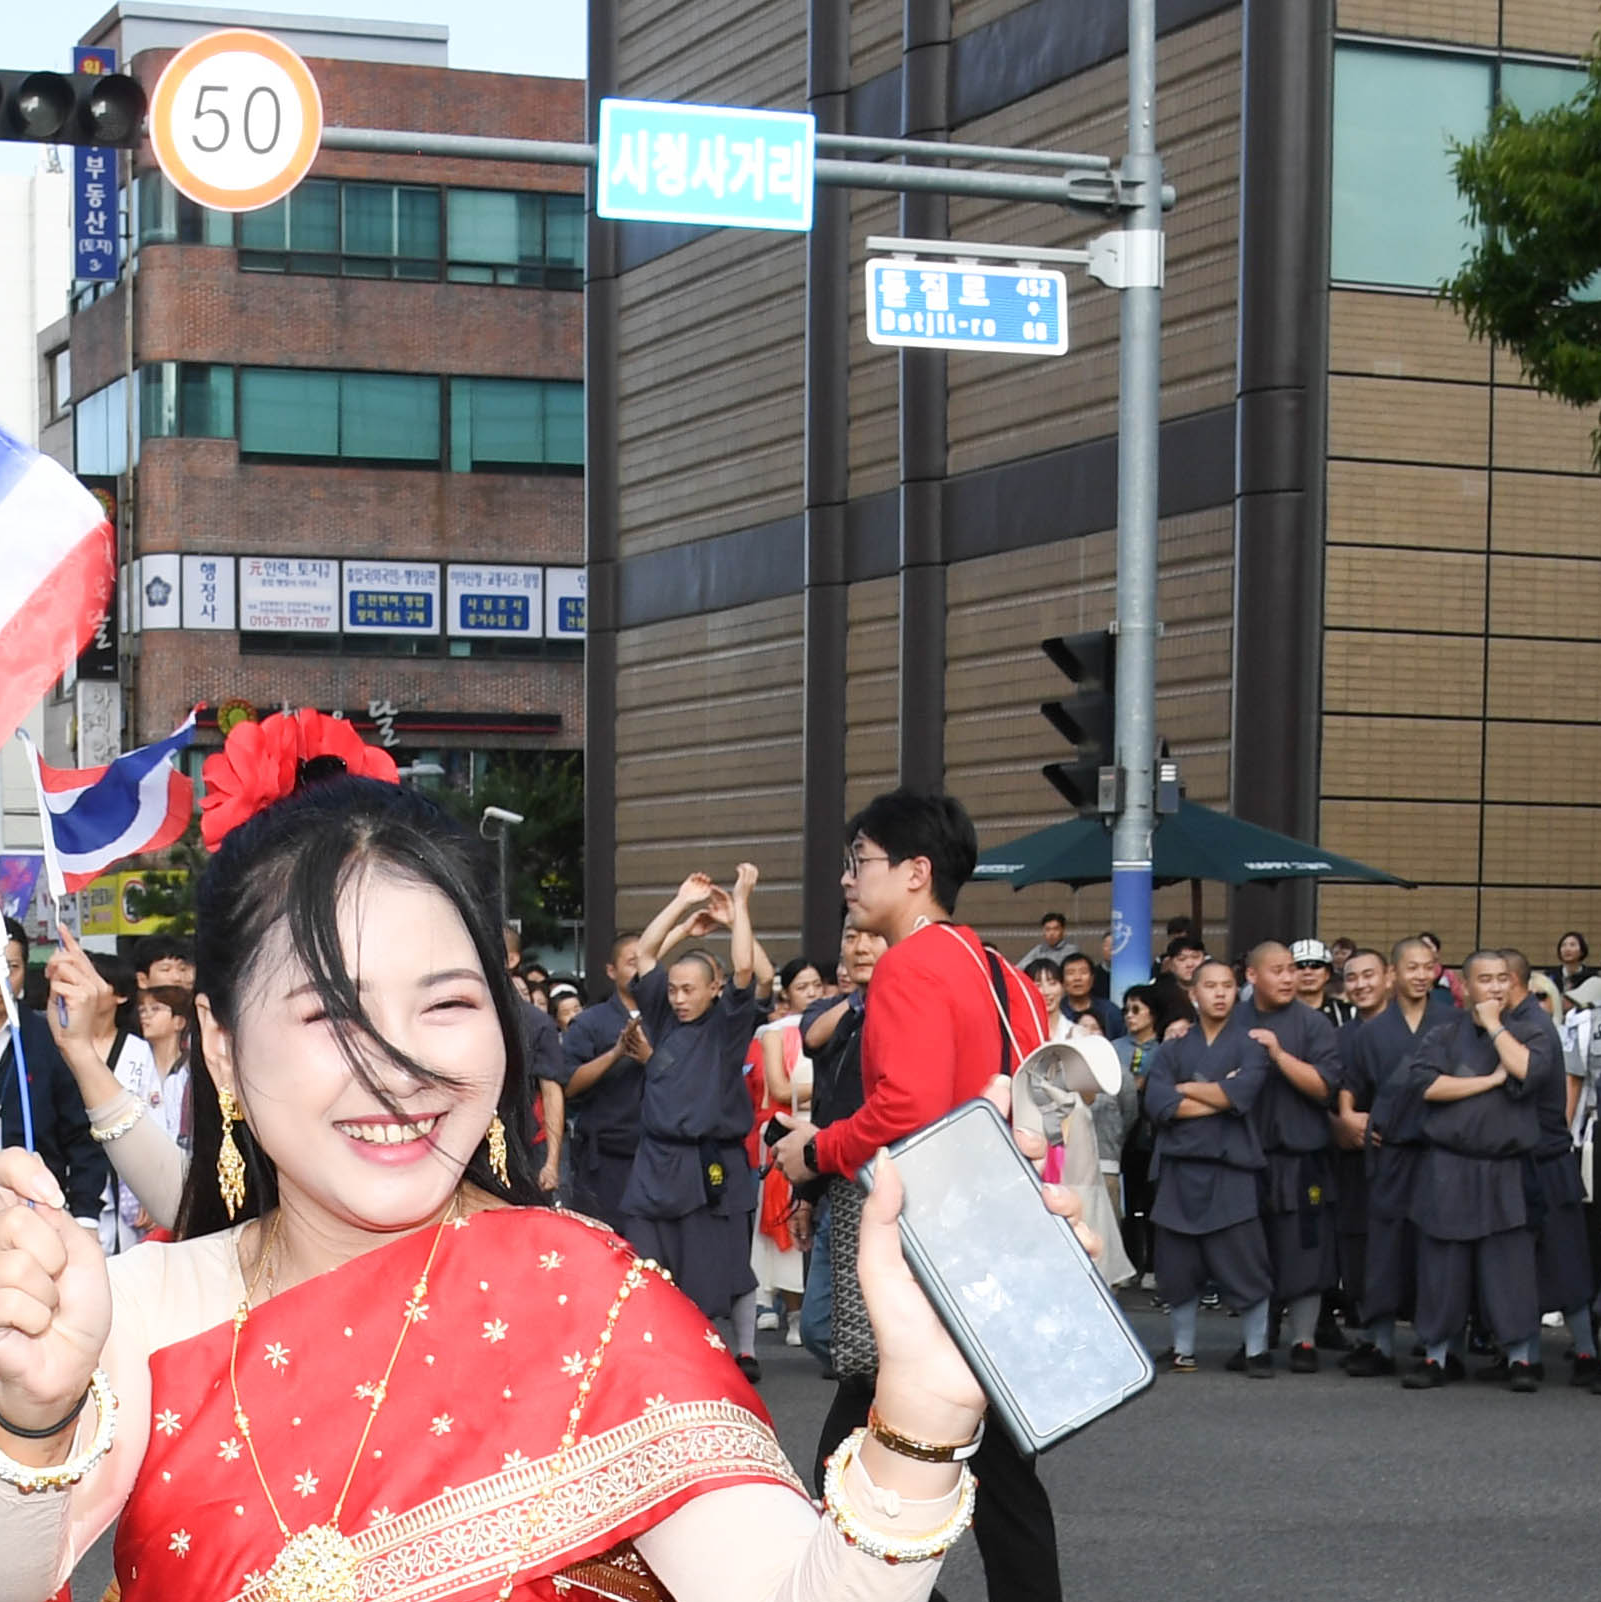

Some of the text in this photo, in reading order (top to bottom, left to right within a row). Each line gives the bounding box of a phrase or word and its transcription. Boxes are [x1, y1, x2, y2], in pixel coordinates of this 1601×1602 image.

[192, 85, 281, 154] 50
[84, 155, 107, 235] 부동산
[611, 130, 803, 204] 시청사거리
[200, 561, 217, 623] 행정사
